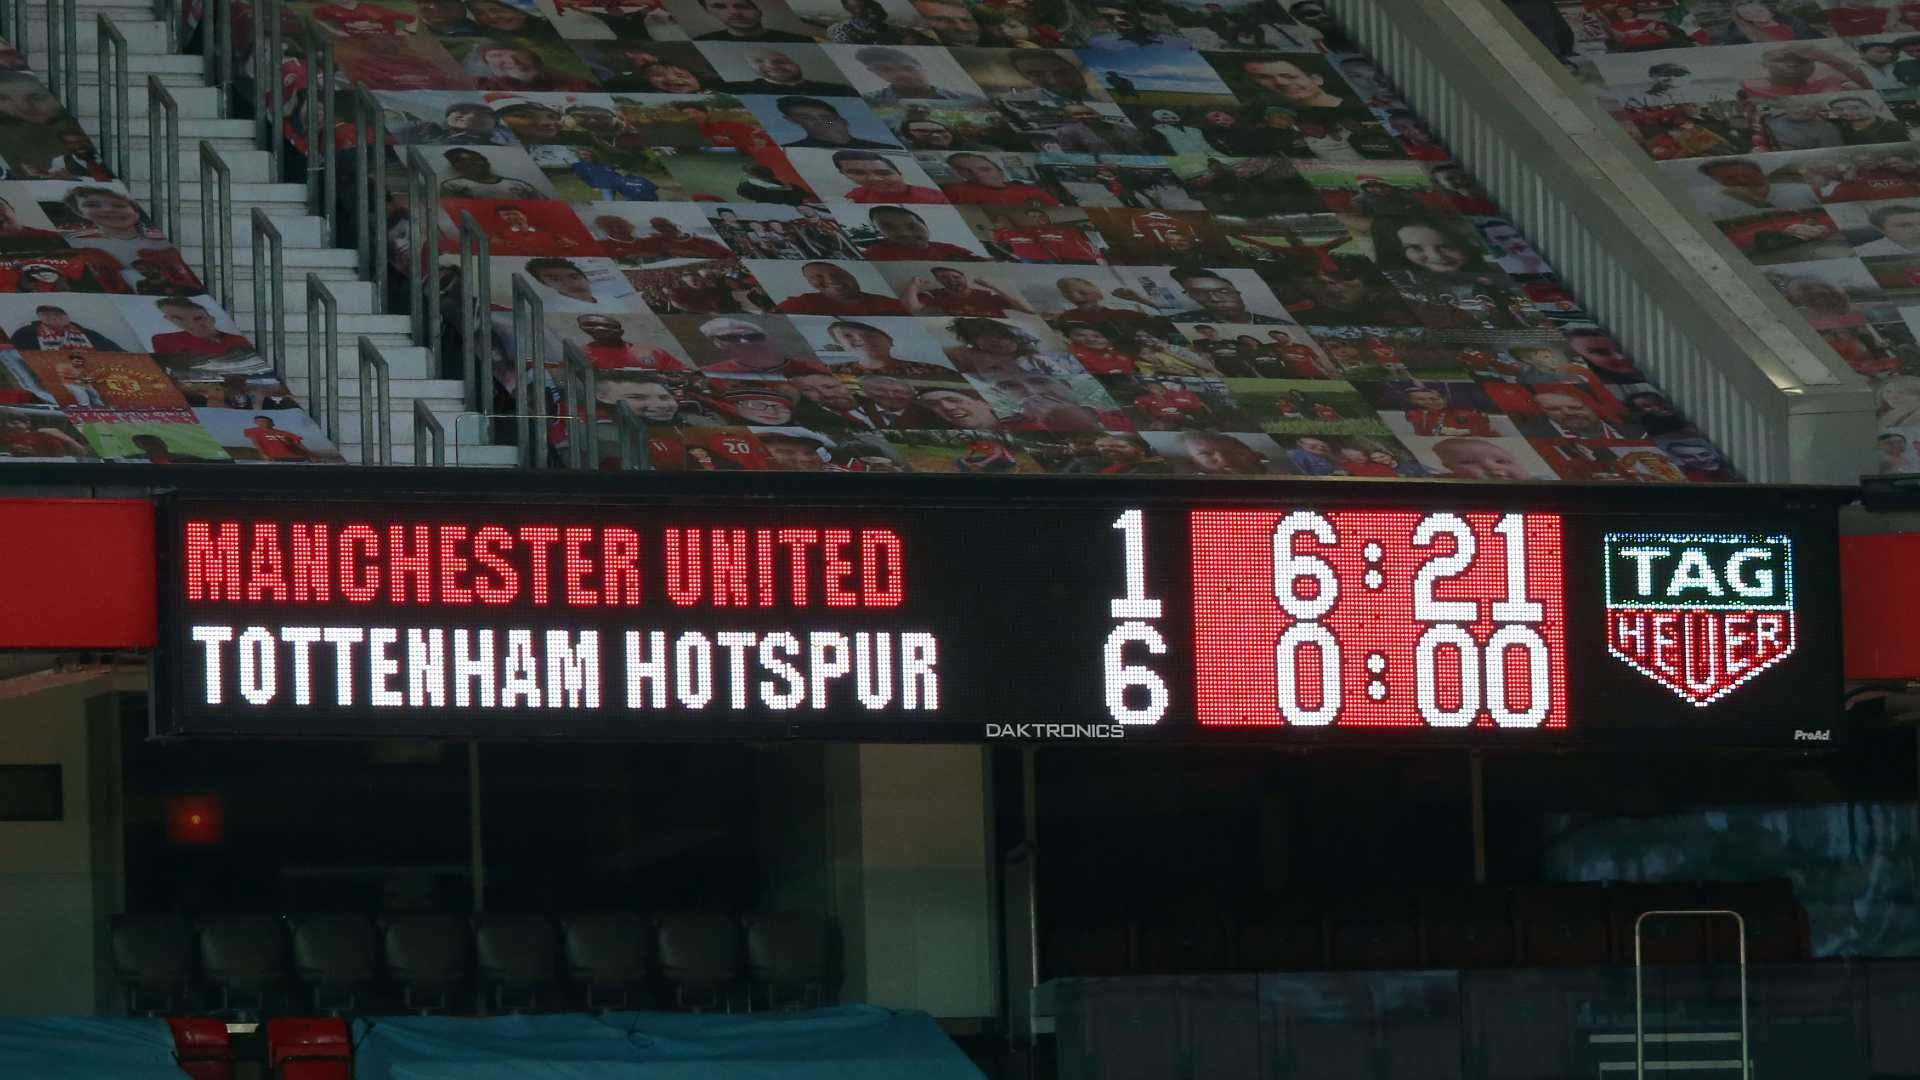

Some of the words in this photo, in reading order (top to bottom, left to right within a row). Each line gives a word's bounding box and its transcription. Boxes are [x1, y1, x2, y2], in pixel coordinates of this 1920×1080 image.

[185, 521, 641, 607] MANCHESTER
[664, 527, 905, 608] UNITED
[1110, 509, 1163, 619] 1
[1273, 511, 1544, 621] 6:21
[1617, 546, 1774, 597] TAG
[192, 625, 602, 709] TOTTENHAM
[624, 630, 940, 711] HOTSPUR
[1103, 621, 1169, 726] 6
[1276, 622, 1550, 729] 0:00
[1617, 613, 1784, 690] HEUER
[985, 723, 1125, 738] DAKTRONICS
[1793, 729, 1831, 741] ProAd
